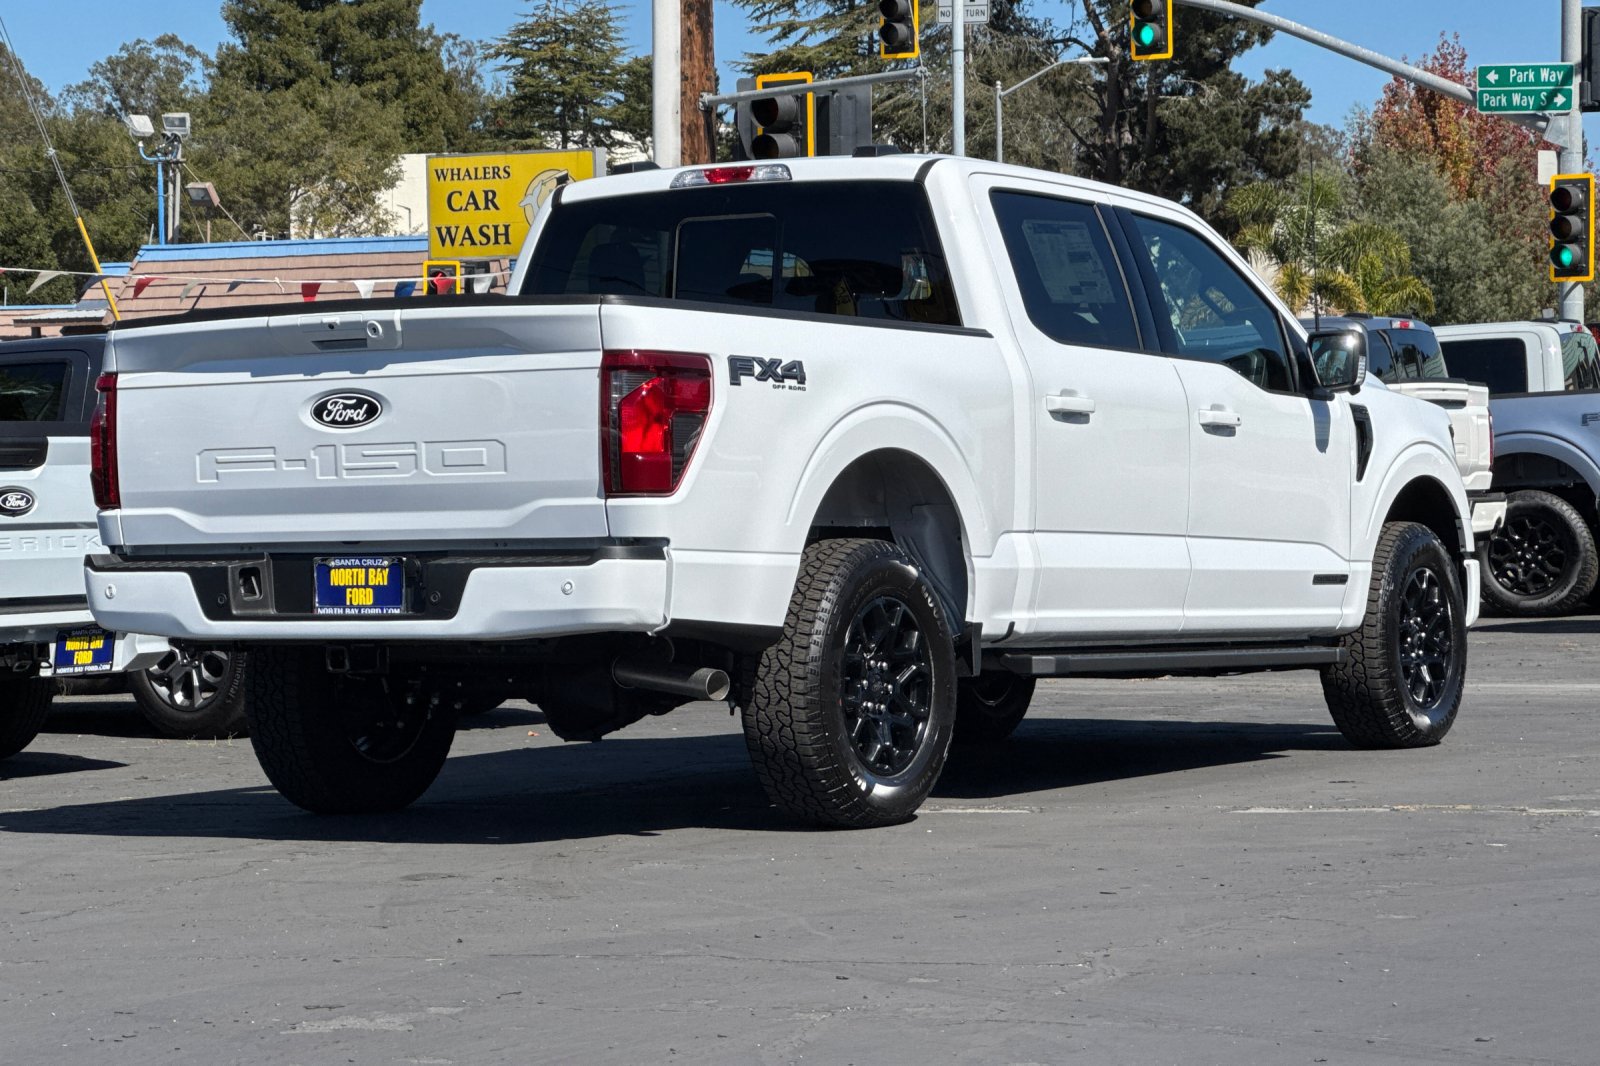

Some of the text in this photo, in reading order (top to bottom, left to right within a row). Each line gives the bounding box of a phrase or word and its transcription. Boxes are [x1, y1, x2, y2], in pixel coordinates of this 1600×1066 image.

[966, 9, 985, 17] TURN
[1509, 68, 1564, 85] Park Way
[1483, 91, 1547, 110] Park Way S
[434, 165, 511, 182] WHALERS
[446, 189, 500, 212] CAR
[435, 224, 512, 247] WASH
[727, 354, 806, 386] FX4
[322, 398, 368, 422] Ford
[196, 439, 507, 483] F-150
[5, 494, 27, 507] Ford
[0, 534, 101, 552] ERICK
[330, 567, 389, 586] NORTH BAY
[345, 587, 373, 606] FORD
[73, 650, 93, 665] FORD
